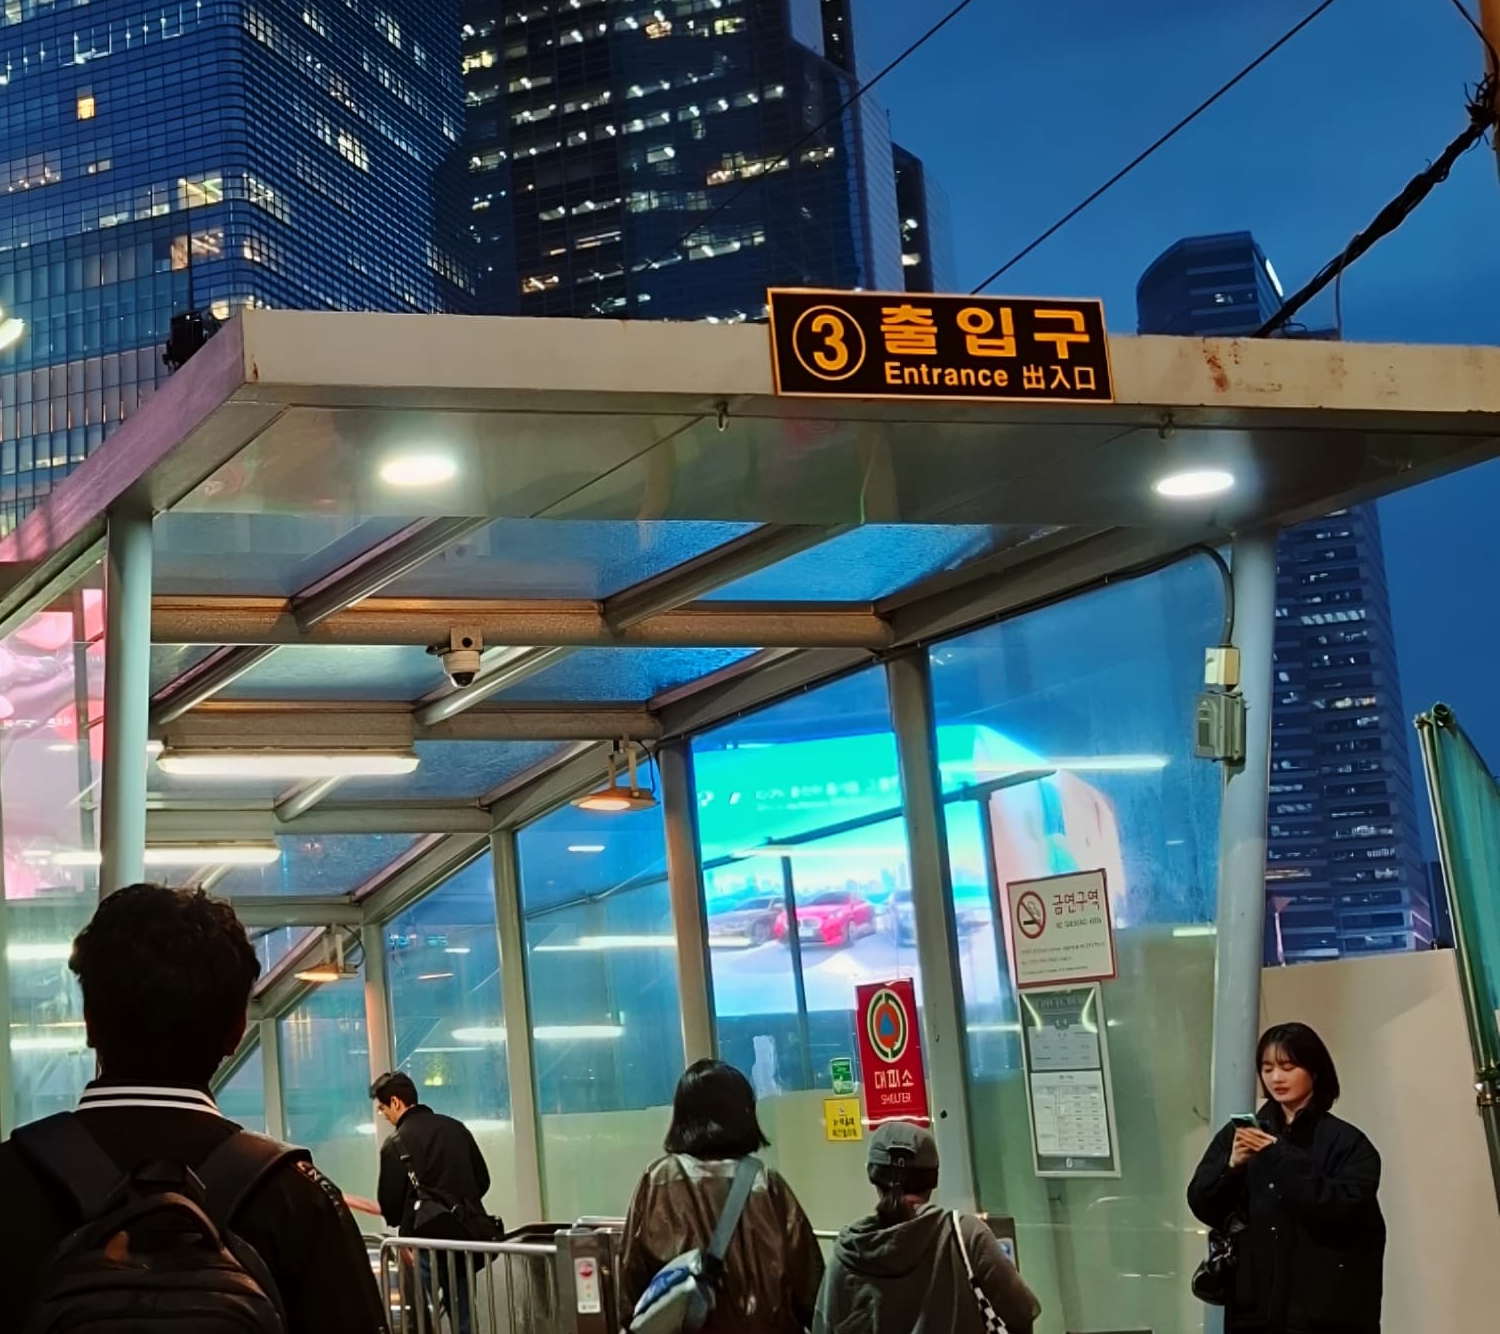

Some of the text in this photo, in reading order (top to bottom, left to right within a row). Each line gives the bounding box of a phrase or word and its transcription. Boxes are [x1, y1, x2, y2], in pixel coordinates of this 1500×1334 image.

[880, 304, 1091, 360] 출입구
[883, 361, 1097, 391] Entrance 出入口
[1052, 889, 1100, 915] 금연구역
[874, 1069, 914, 1089] 대피소
